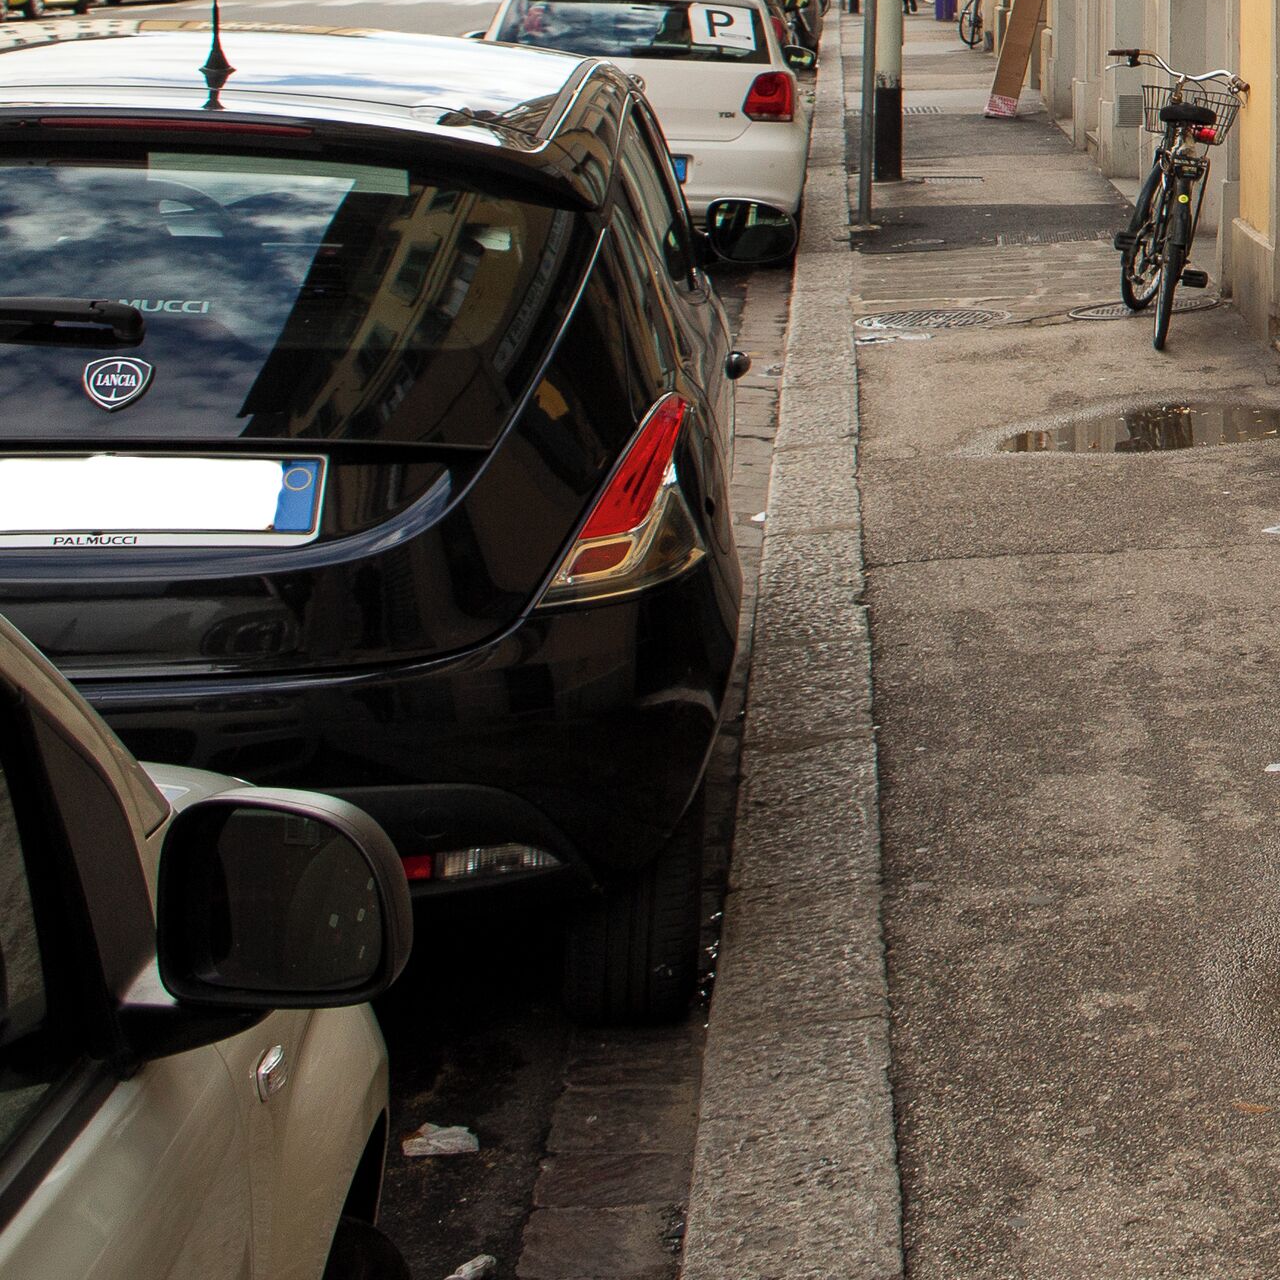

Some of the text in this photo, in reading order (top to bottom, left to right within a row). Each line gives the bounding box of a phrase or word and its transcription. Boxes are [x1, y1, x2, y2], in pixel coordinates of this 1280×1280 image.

[704, 9, 735, 38] P
[95, 373, 137, 387] LANCIA
[53, 535, 138, 546] PALMUCCI
